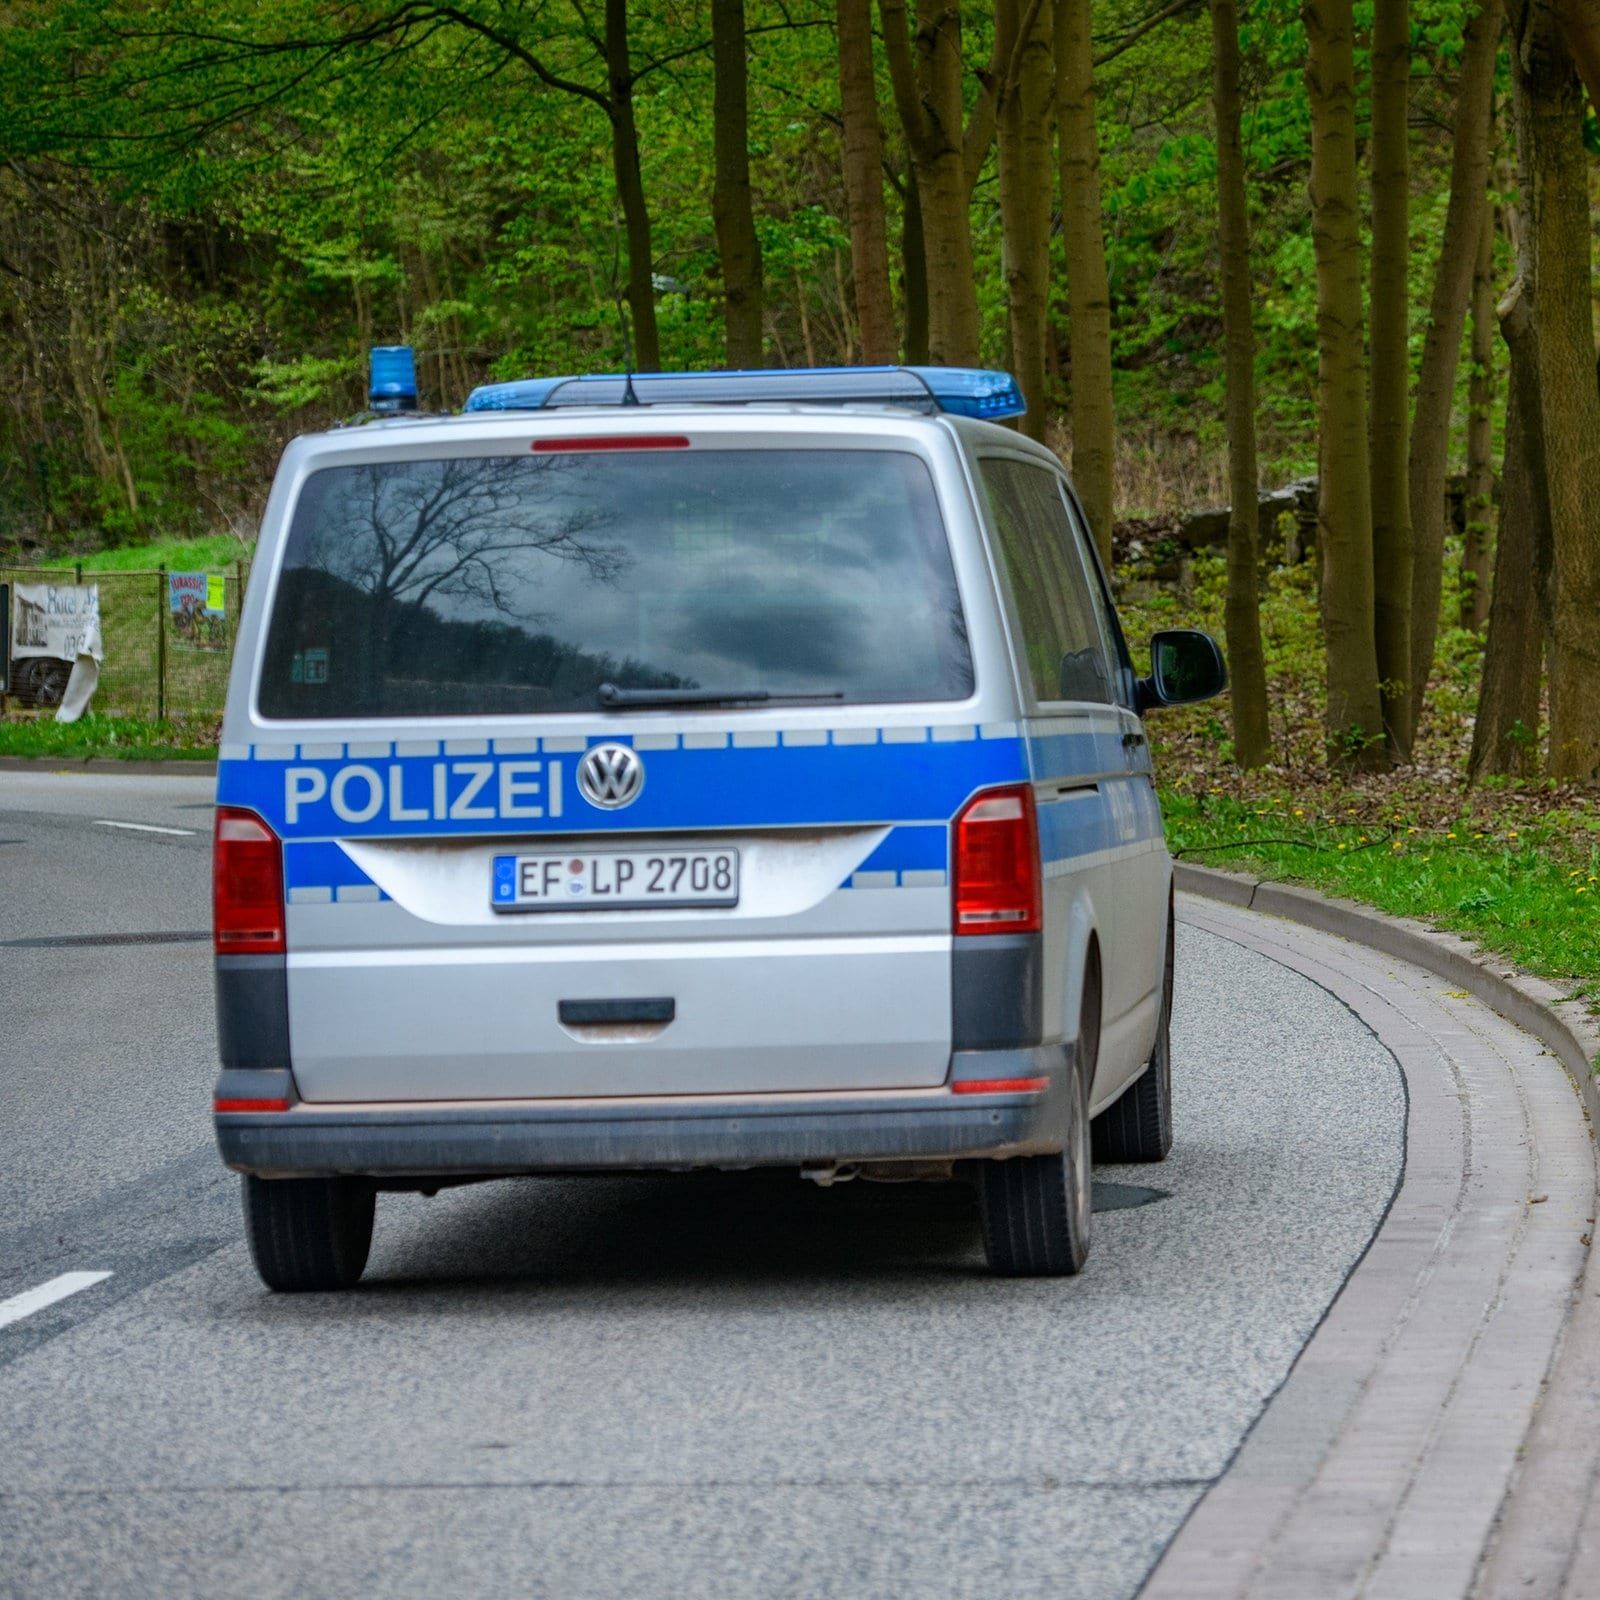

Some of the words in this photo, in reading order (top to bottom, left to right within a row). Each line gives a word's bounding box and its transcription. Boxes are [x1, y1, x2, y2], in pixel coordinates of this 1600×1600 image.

[285, 760, 562, 824] POLIZEI
[519, 861, 562, 897] EF
[591, 859, 634, 894] LP
[646, 856, 732, 892] 2708
